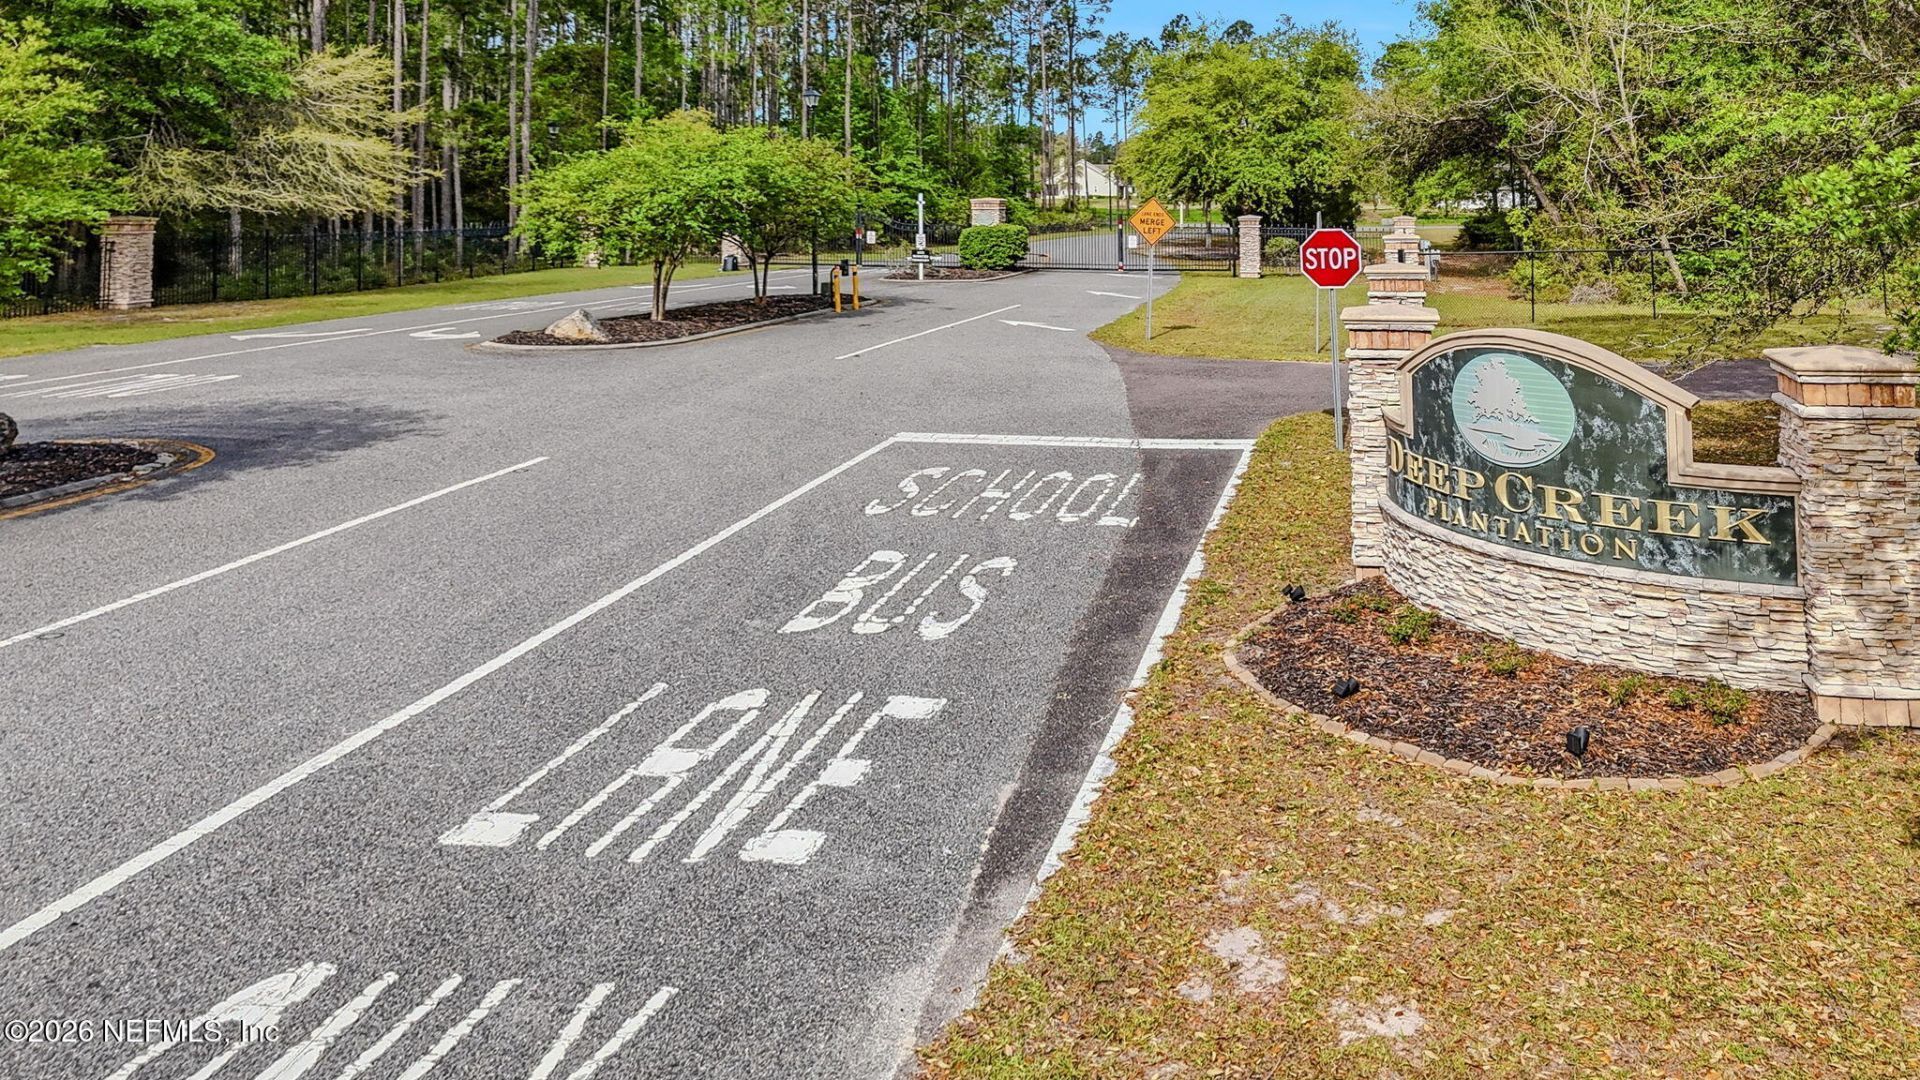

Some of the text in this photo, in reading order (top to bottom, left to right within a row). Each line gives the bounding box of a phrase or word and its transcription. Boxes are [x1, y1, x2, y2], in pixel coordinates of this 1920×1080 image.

[1139, 218, 1165, 227] MERGE
[1142, 227, 1161, 235] LEFT
[1305, 247, 1357, 270] STOP
[864, 467, 1142, 527] SCHOOL
[1388, 435, 1772, 546] DEEP CREEK
[1426, 495, 1639, 561] PLANTATION
[777, 550, 1018, 640] BUS
[438, 682, 947, 864] LANE
